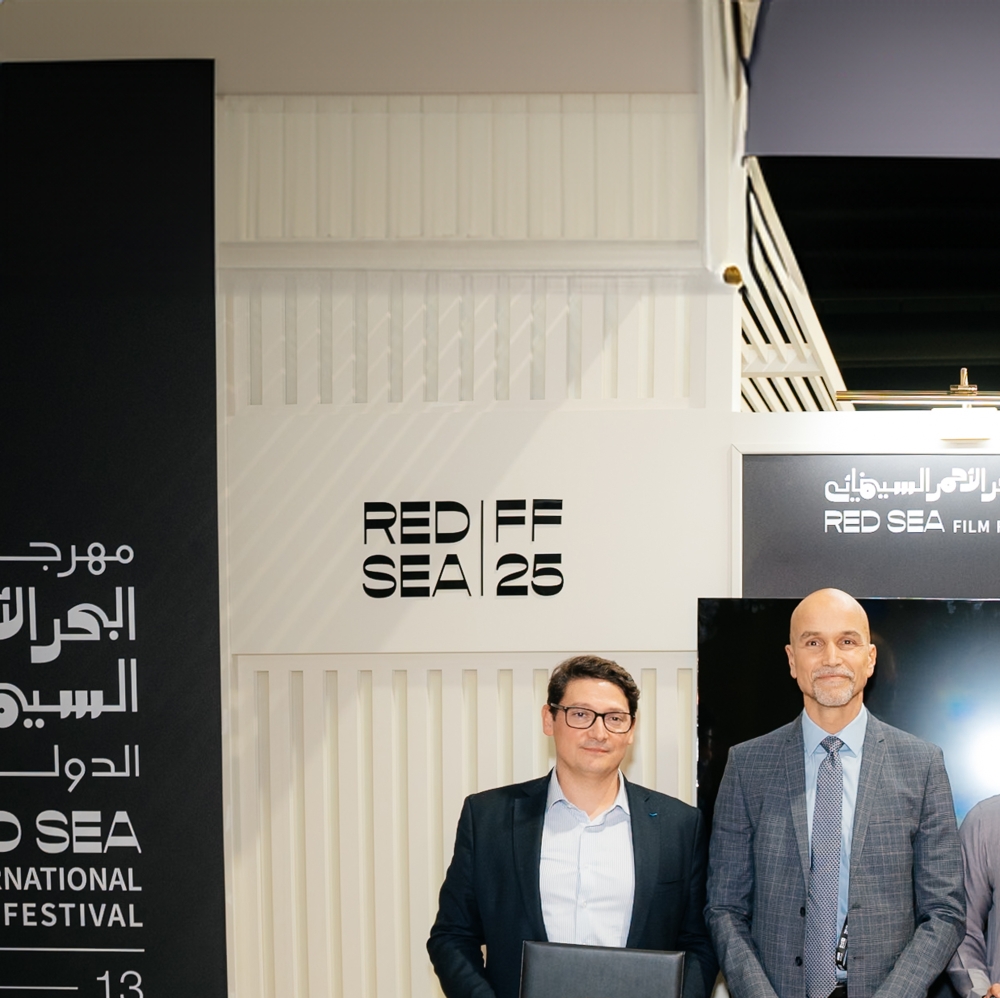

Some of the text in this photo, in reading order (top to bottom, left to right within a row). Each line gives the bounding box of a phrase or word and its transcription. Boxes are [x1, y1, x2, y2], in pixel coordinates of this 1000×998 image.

[824, 467, 931, 502] السينمائي
[925, 467, 986, 502] الأحمر
[363, 499, 563, 544] RED FF
[824, 510, 881, 533] RED
[887, 509, 945, 533] SEA
[953, 519, 990, 533] FILM
[0, 542, 134, 577] مهرج
[363, 552, 564, 598] SEA 25
[30, 586, 136, 664] البحر
[0, 744, 140, 793] الدول
[36, 809, 142, 853] SEA
[0, 866, 142, 891] NATIONAL
[4, 902, 143, 927] FESTIVAL
